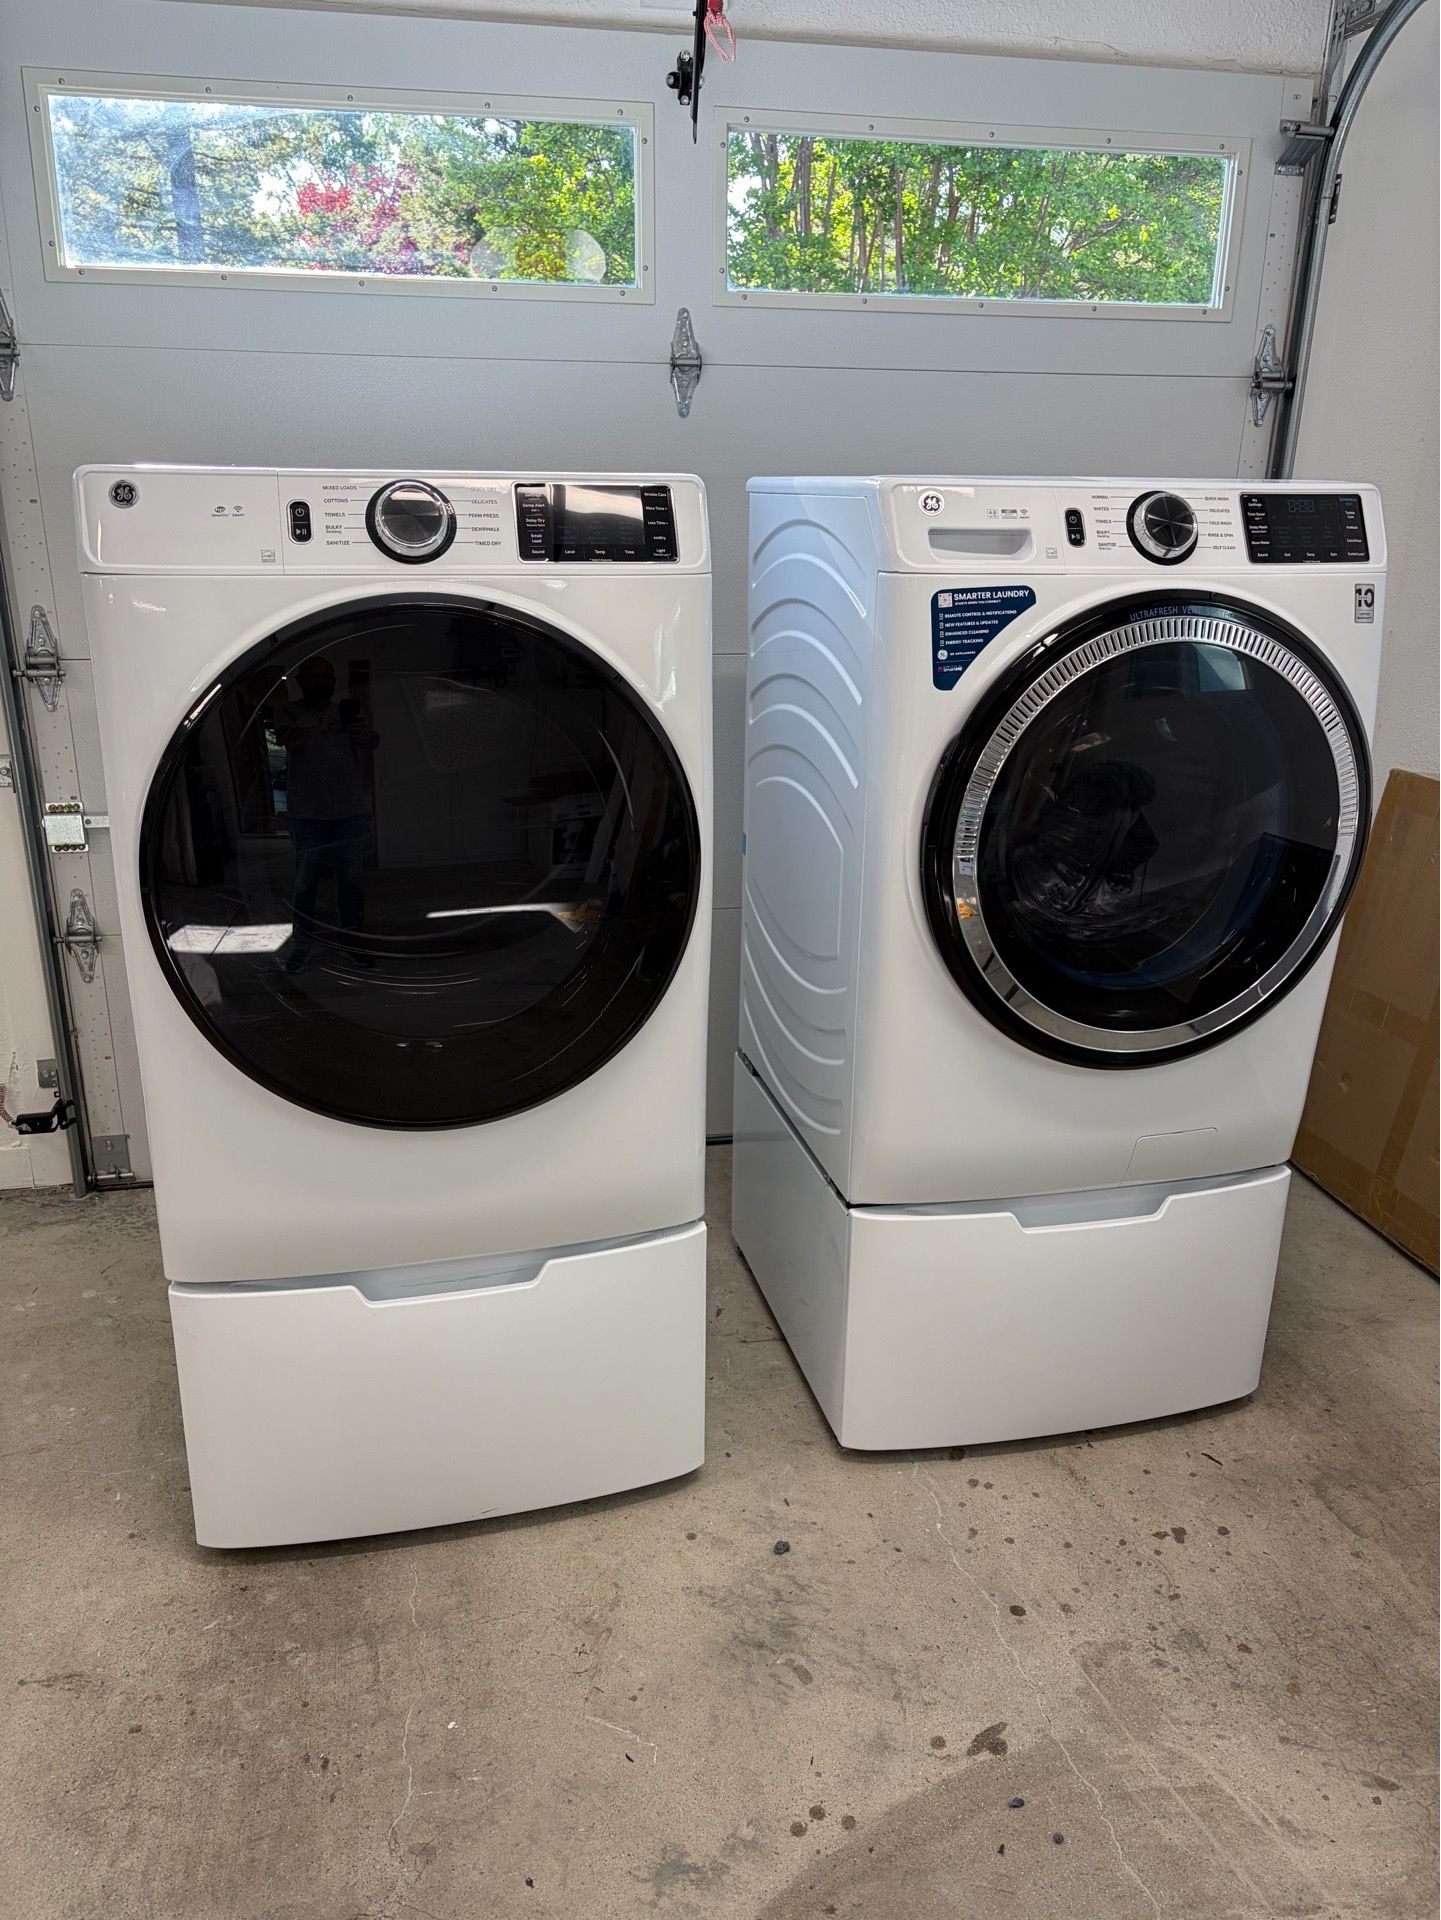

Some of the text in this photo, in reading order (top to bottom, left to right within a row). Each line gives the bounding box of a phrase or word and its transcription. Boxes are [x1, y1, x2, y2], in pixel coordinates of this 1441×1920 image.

[954, 590, 1029, 600] SMARTER LAUNDRY
[1355, 588, 1375, 608] 10
[1129, 605, 1178, 621] ULTRAFRESH
